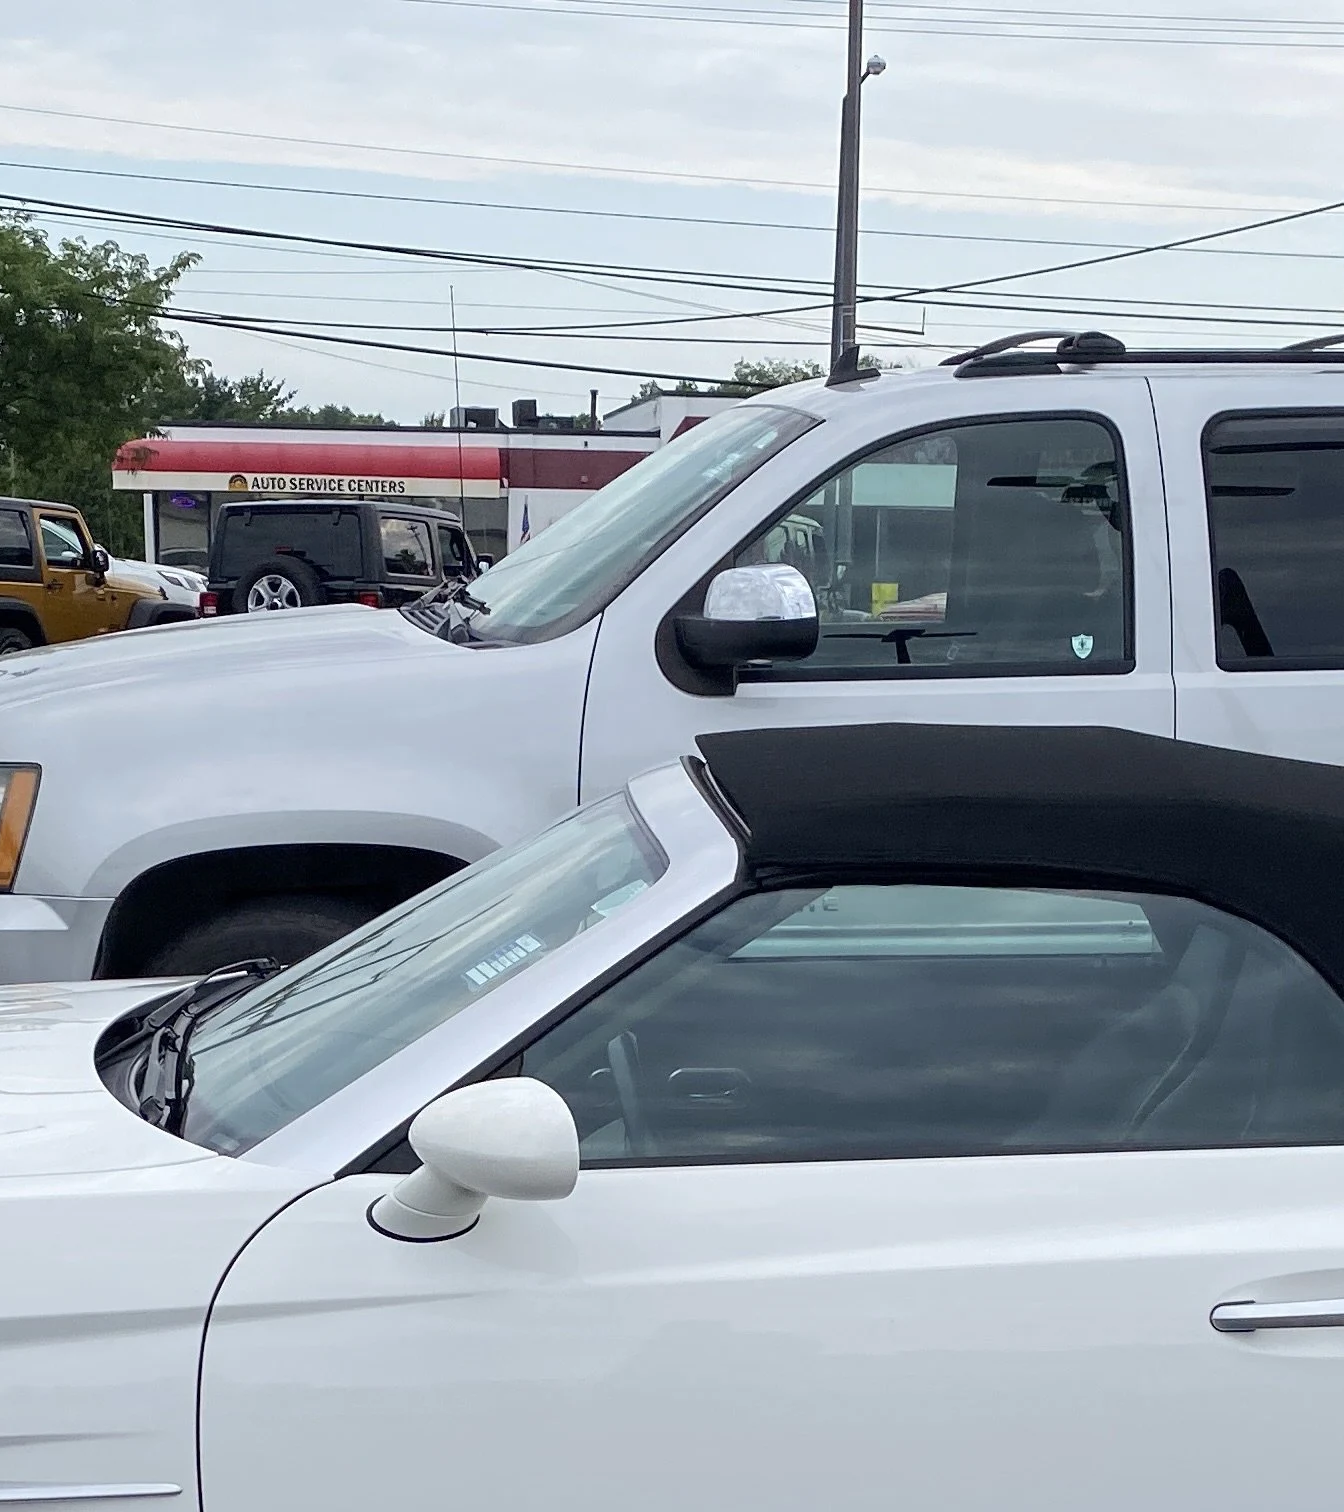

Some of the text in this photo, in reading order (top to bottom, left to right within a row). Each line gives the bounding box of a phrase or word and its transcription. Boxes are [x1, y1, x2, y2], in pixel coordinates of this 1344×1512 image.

[251, 477, 405, 493] AUTO SERVICE CENTERS
